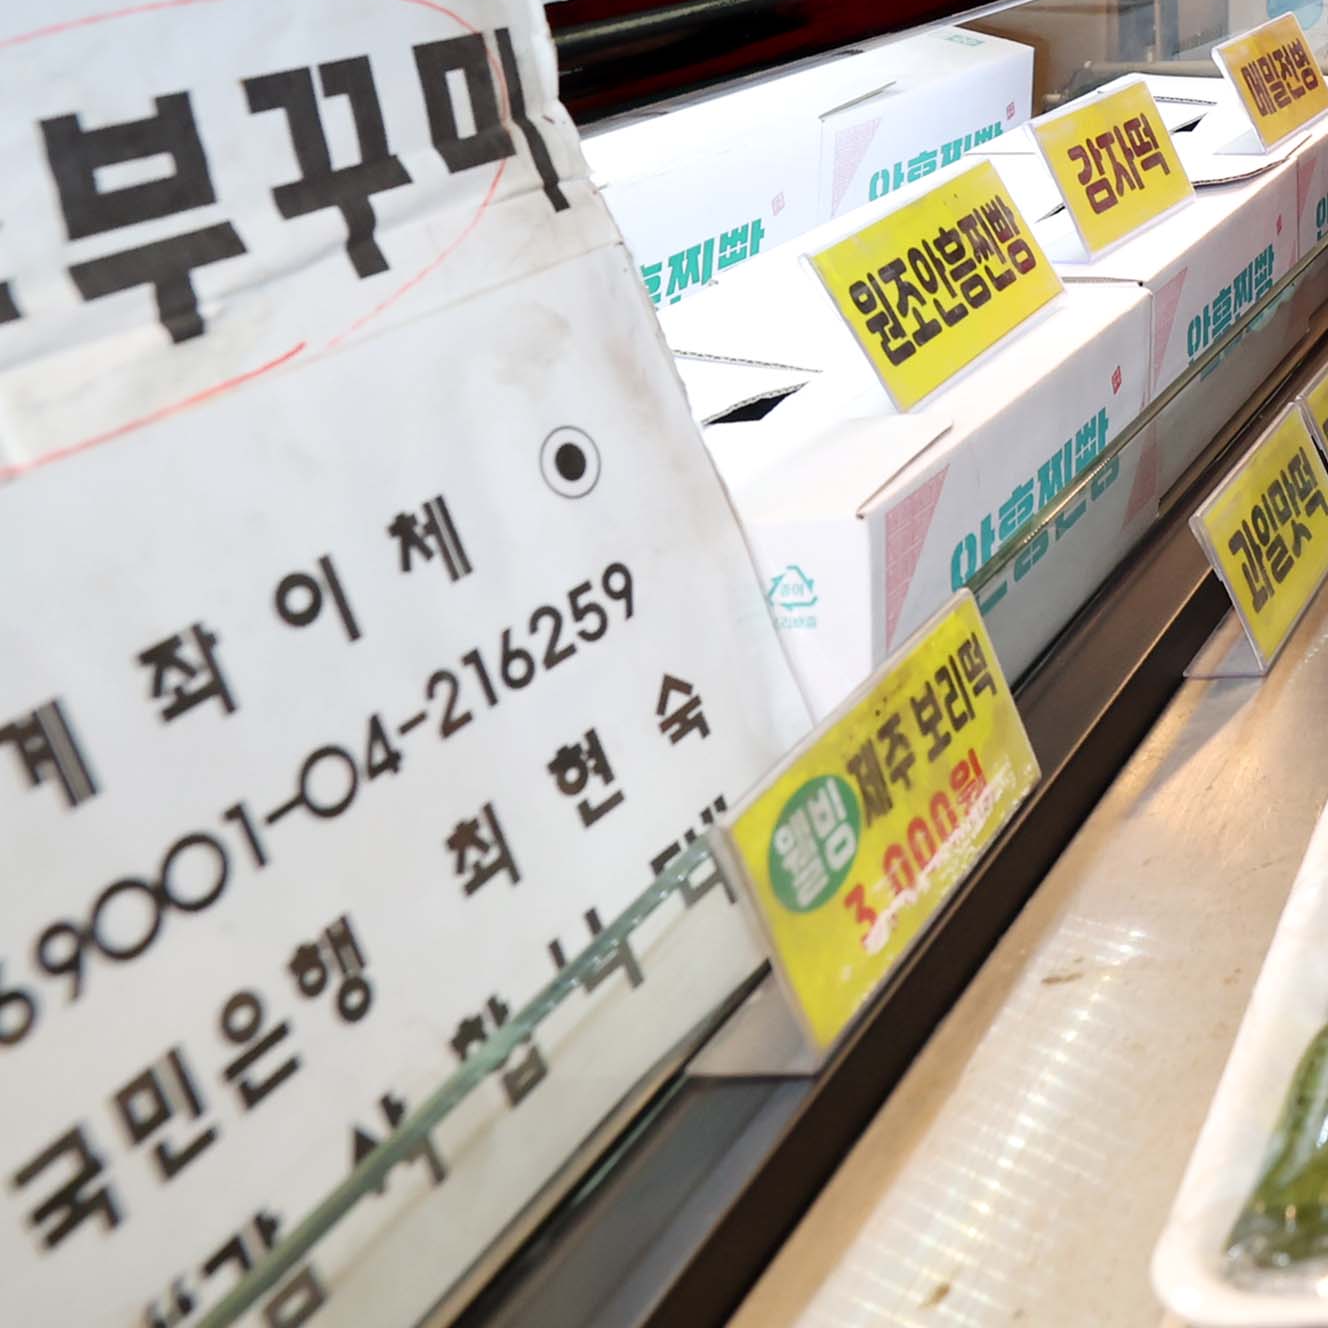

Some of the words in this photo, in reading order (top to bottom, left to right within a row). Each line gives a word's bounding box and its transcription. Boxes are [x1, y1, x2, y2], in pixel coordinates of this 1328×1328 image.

[0, 27, 570, 344] 부꾸미
[1076, 112, 1168, 214] 감자떡
[1240, 38, 1319, 118] 메밀전병
[849, 194, 1038, 366] 원조안흥찐빵
[0, 494, 472, 808] 계좌이체
[773, 778, 858, 908] 웰빙
[846, 710, 919, 828] 제주
[910, 632, 998, 764] 보리떡
[8, 915, 374, 1253] 국민은행
[443, 673, 713, 898] 최현숙
